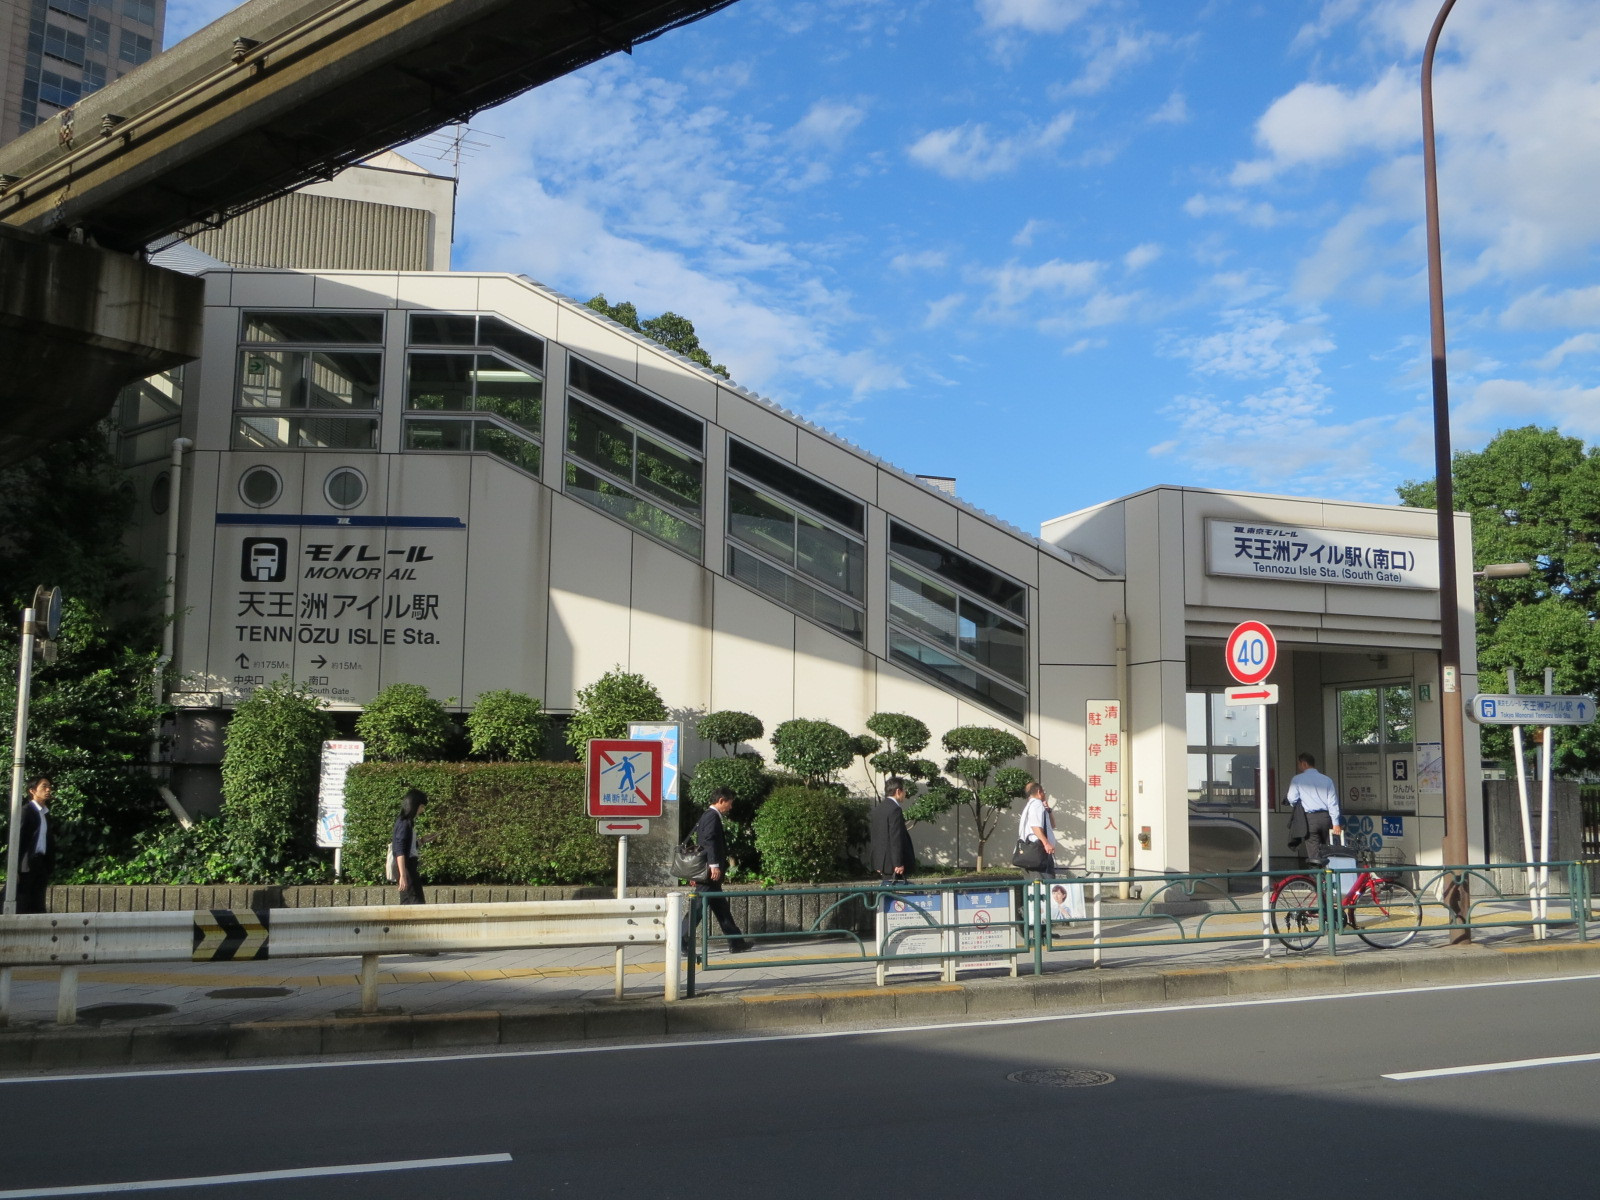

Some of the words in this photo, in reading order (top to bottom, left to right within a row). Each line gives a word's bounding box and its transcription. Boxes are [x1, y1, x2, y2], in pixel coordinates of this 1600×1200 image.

[305, 544, 434, 563] モノレール
[1234, 536, 1415, 572] 天王洲アイル駅（南口）
[1253, 561, 1297, 576] Tennozu
[1299, 565, 1317, 577] Isle
[1319, 567, 1340, 579] Sta.
[1342, 569, 1374, 582] (South
[1376, 571, 1402, 584] Gate)
[237, 591, 439, 621] 天王洲アイル駅
[348, 627, 396, 646] ISLE
[402, 627, 441, 646] Sta.
[1237, 638, 1264, 666] 40
[233, 675, 264, 686] 中央口
[308, 675, 329, 687] 南口
[308, 687, 330, 695] South
[331, 687, 350, 696] Gate
[1088, 712, 1102, 851] 駐停車禁止
[1104, 705, 1118, 858] 清掃車出入口
[603, 792, 637, 804] 横断禁止
[970, 895, 993, 905] 警告
